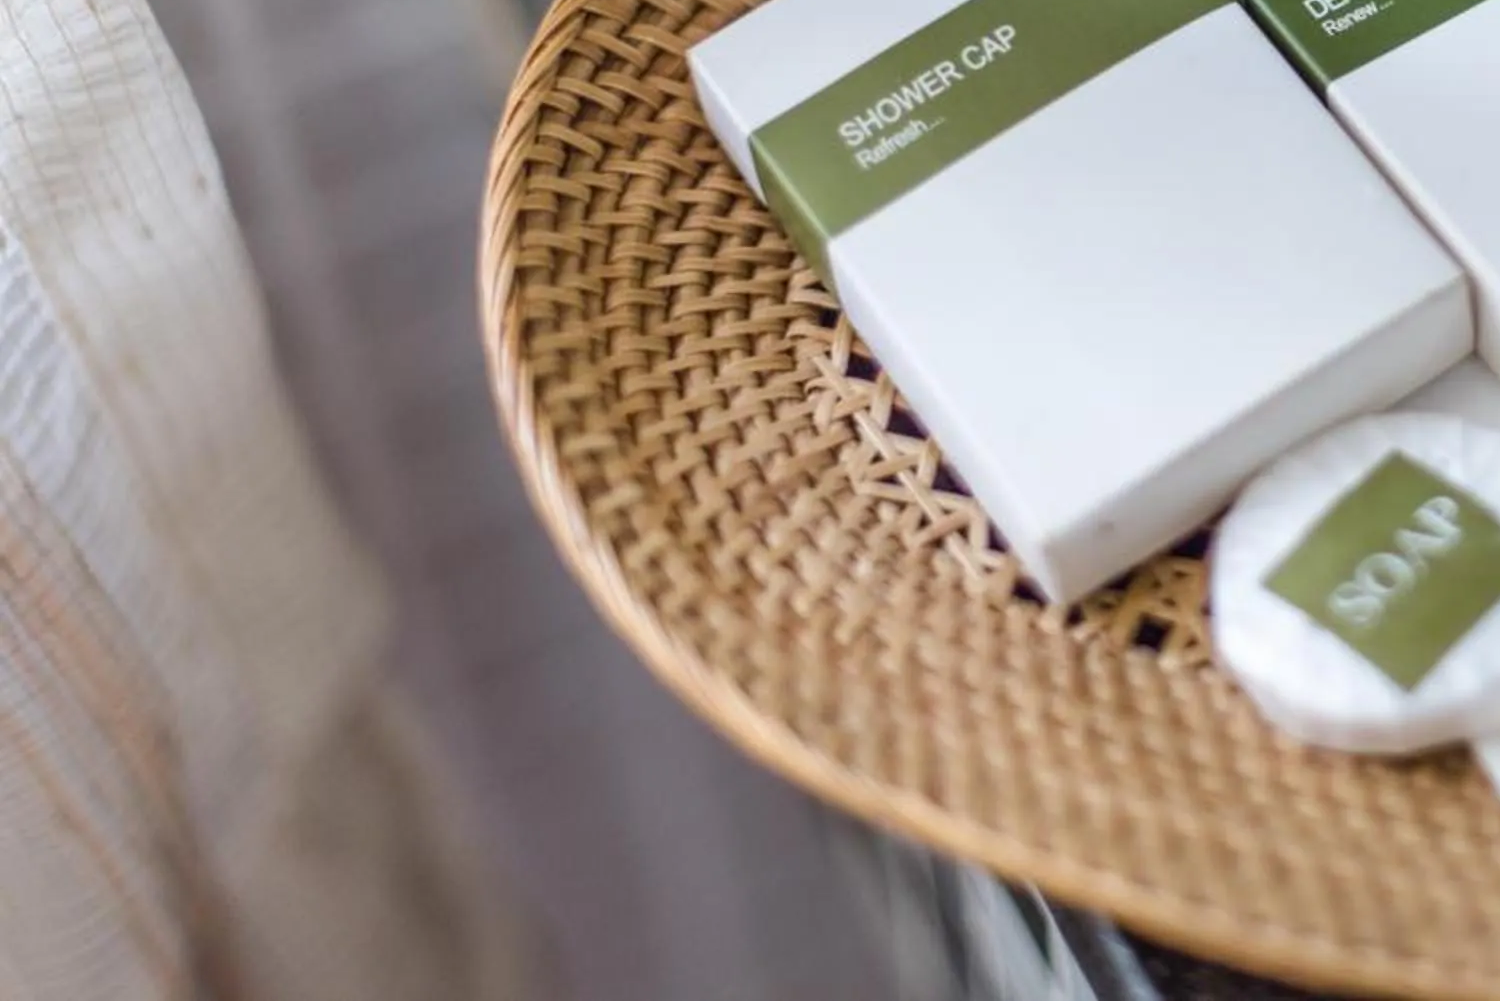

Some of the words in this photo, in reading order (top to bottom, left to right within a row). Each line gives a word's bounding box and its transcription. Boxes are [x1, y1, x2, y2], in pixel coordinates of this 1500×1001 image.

[838, 59, 964, 147] SHOWER
[960, 24, 1017, 71] CAP
[1327, 495, 1462, 631] SOAP
